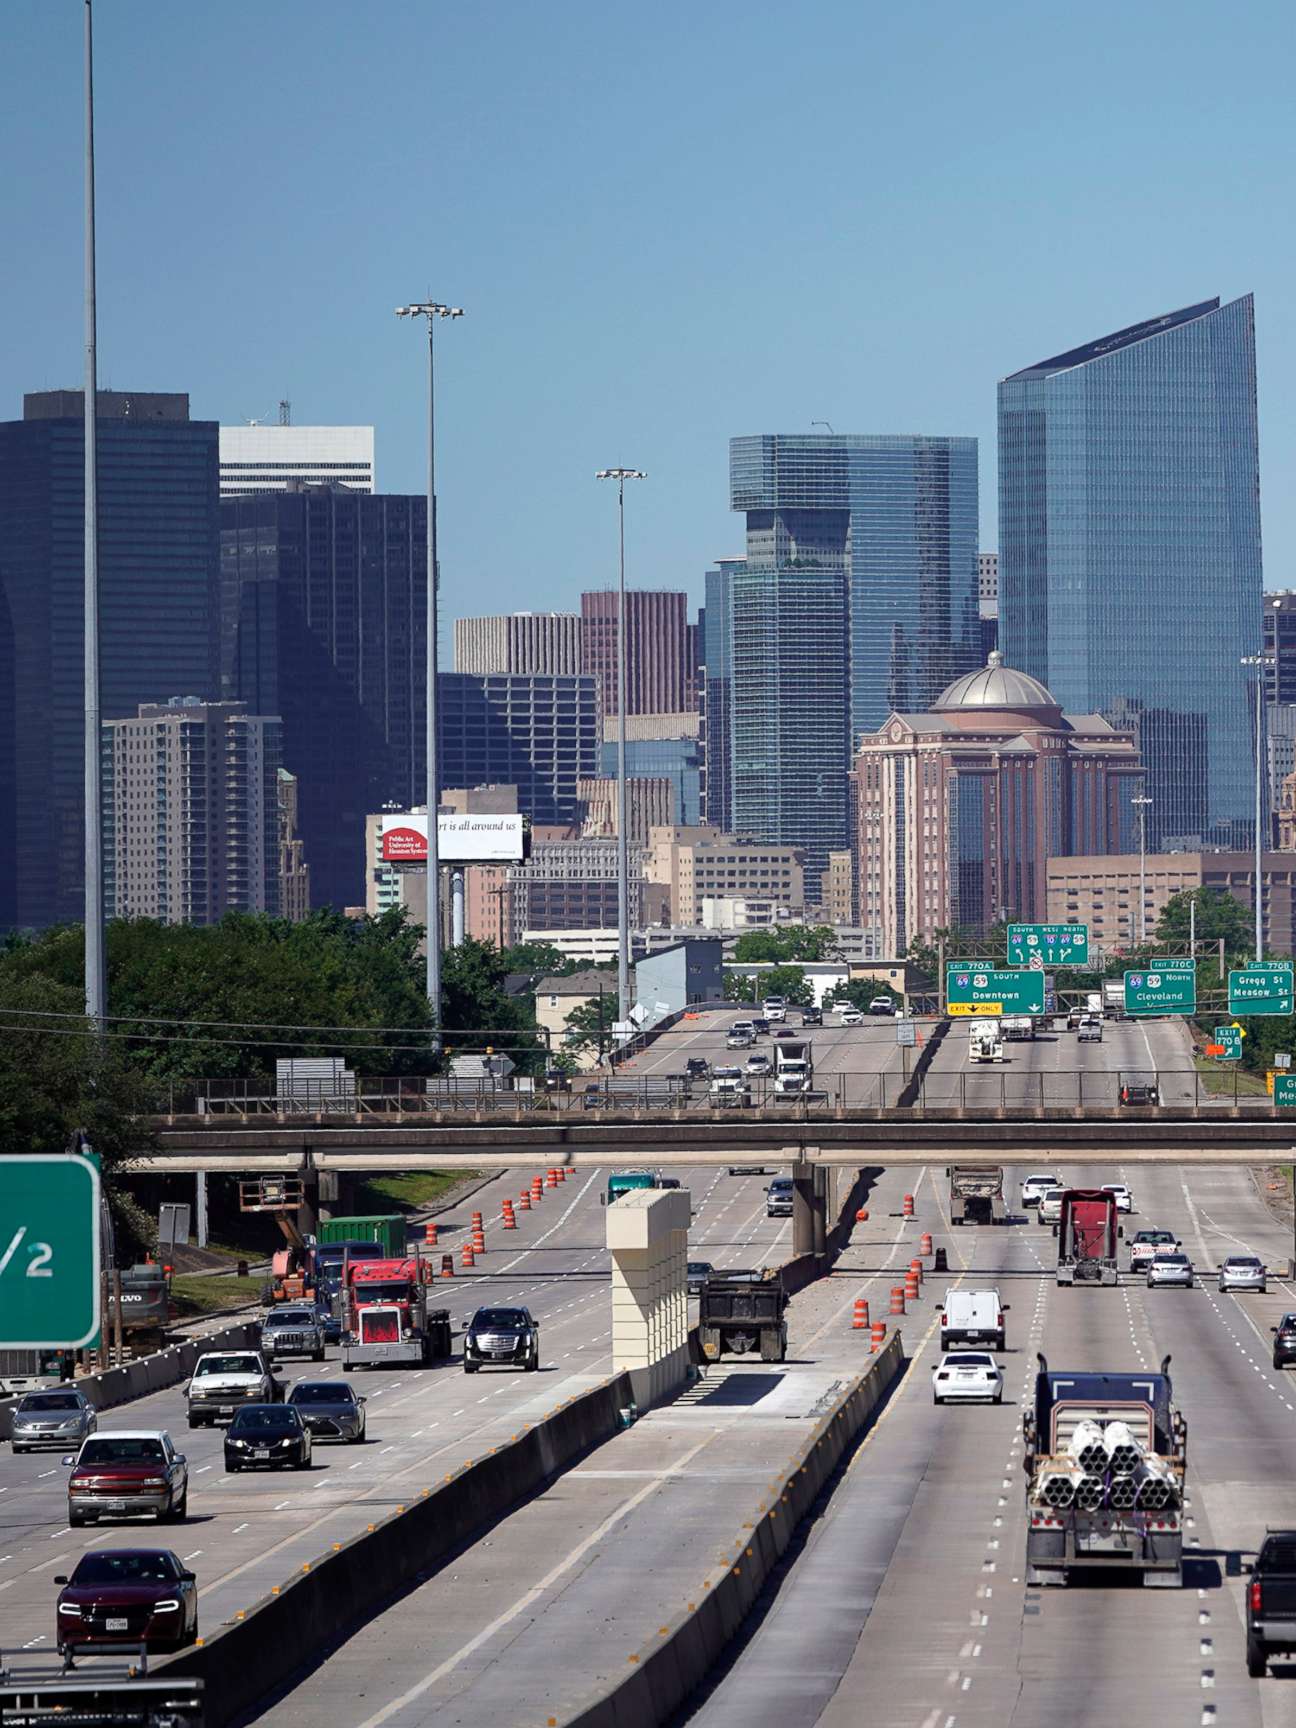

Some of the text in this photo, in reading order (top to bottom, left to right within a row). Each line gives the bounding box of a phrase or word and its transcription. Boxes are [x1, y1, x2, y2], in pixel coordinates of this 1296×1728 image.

[449, 822, 457, 831] is
[458, 821, 470, 831] all
[471, 821, 504, 831] around
[506, 823, 517, 831] us
[957, 976, 969, 986] 69
[1130, 977, 1142, 986] 69
[1238, 975, 1284, 986] Gregg St
[972, 991, 1020, 1000] Downtown
[1136, 992, 1183, 1001] Cleveland
[1233, 988, 1289, 997] Meadow St
